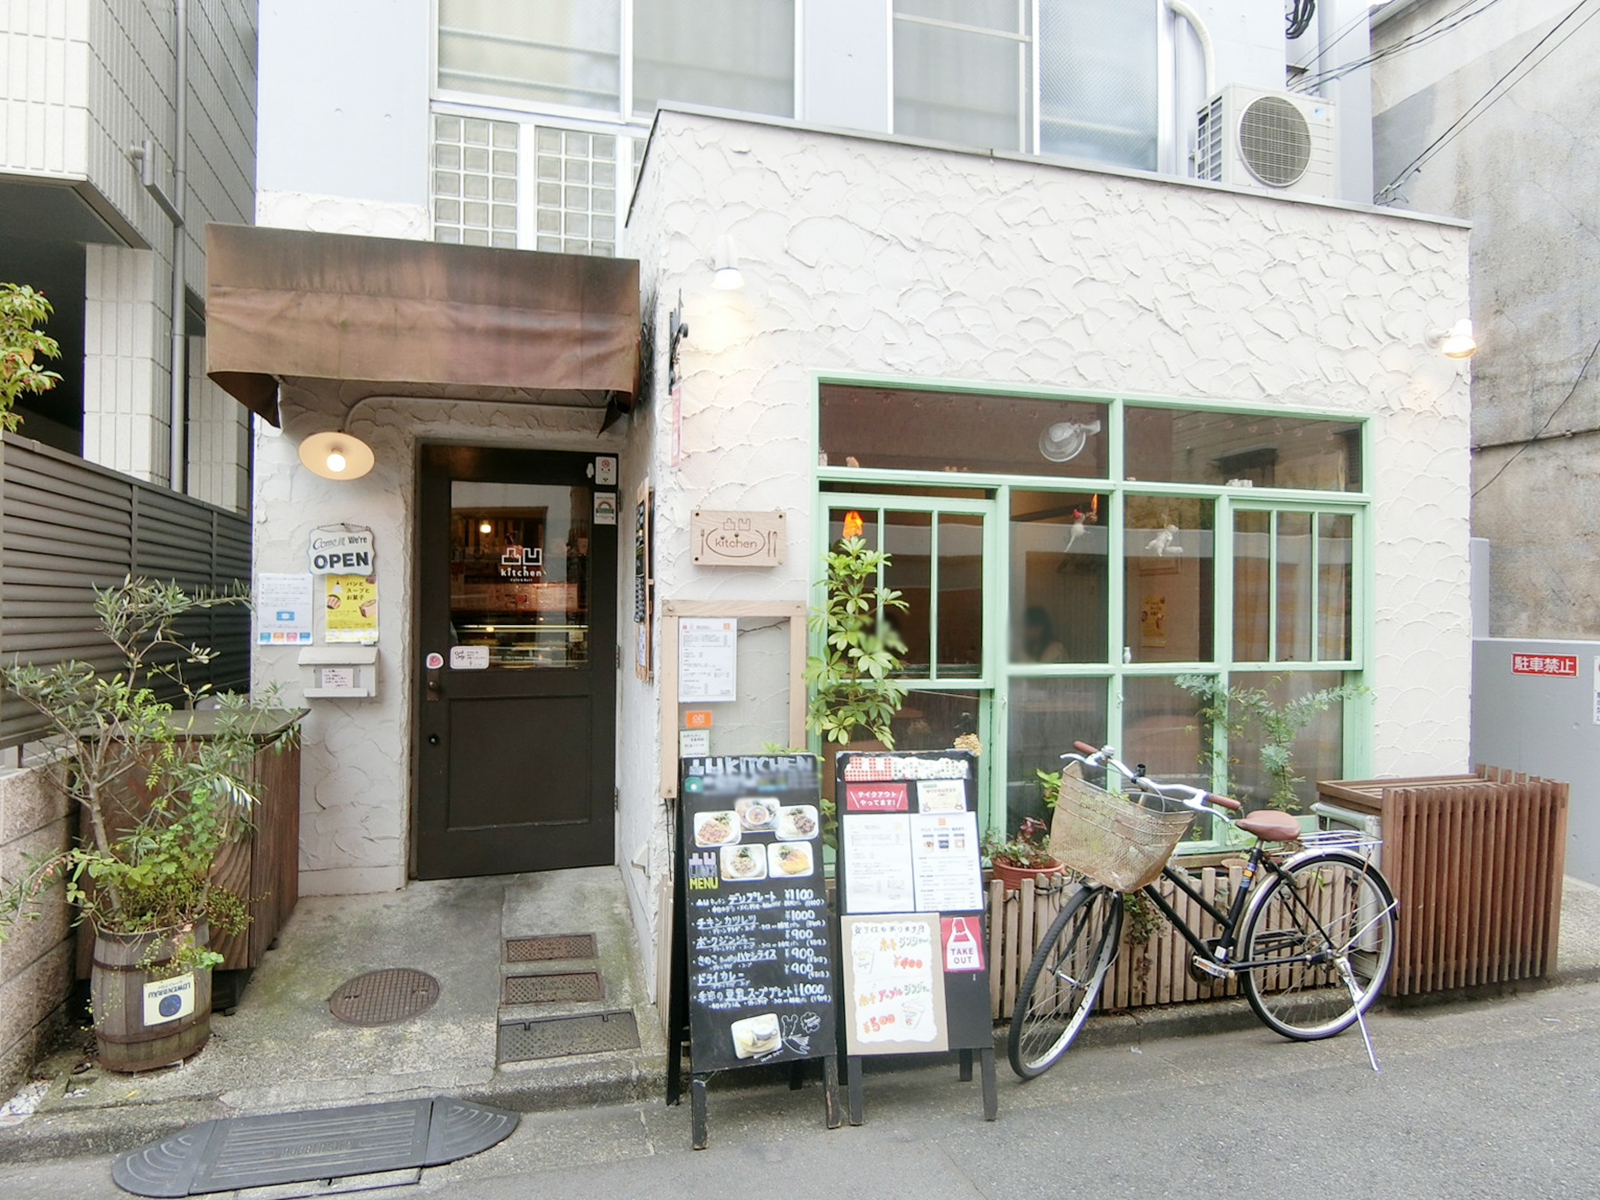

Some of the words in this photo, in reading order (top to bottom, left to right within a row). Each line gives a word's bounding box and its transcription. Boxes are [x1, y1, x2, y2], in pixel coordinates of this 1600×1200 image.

[313, 537, 336, 550] Come
[348, 536, 368, 545] We're
[715, 535, 758, 549] kitchen
[313, 551, 370, 570] OPEN
[500, 566, 543, 577] kitchen
[1513, 656, 1575, 674] 駐車禁止
[857, 790, 897, 798] テイクアウト
[689, 877, 719, 890] MENU
[784, 889, 815, 901] ¥1100
[696, 915, 757, 930] チキンカツレツ
[785, 909, 816, 921] ¥1000
[785, 928, 815, 940] ¥900
[784, 947, 815, 960] ¥900
[951, 947, 973, 955] TAKE
[893, 954, 923, 969] ¥400
[953, 956, 973, 965] OUT
[697, 971, 746, 986] ドライカレー
[784, 963, 815, 975] ¥900
[862, 1013, 896, 1034] ¥500
